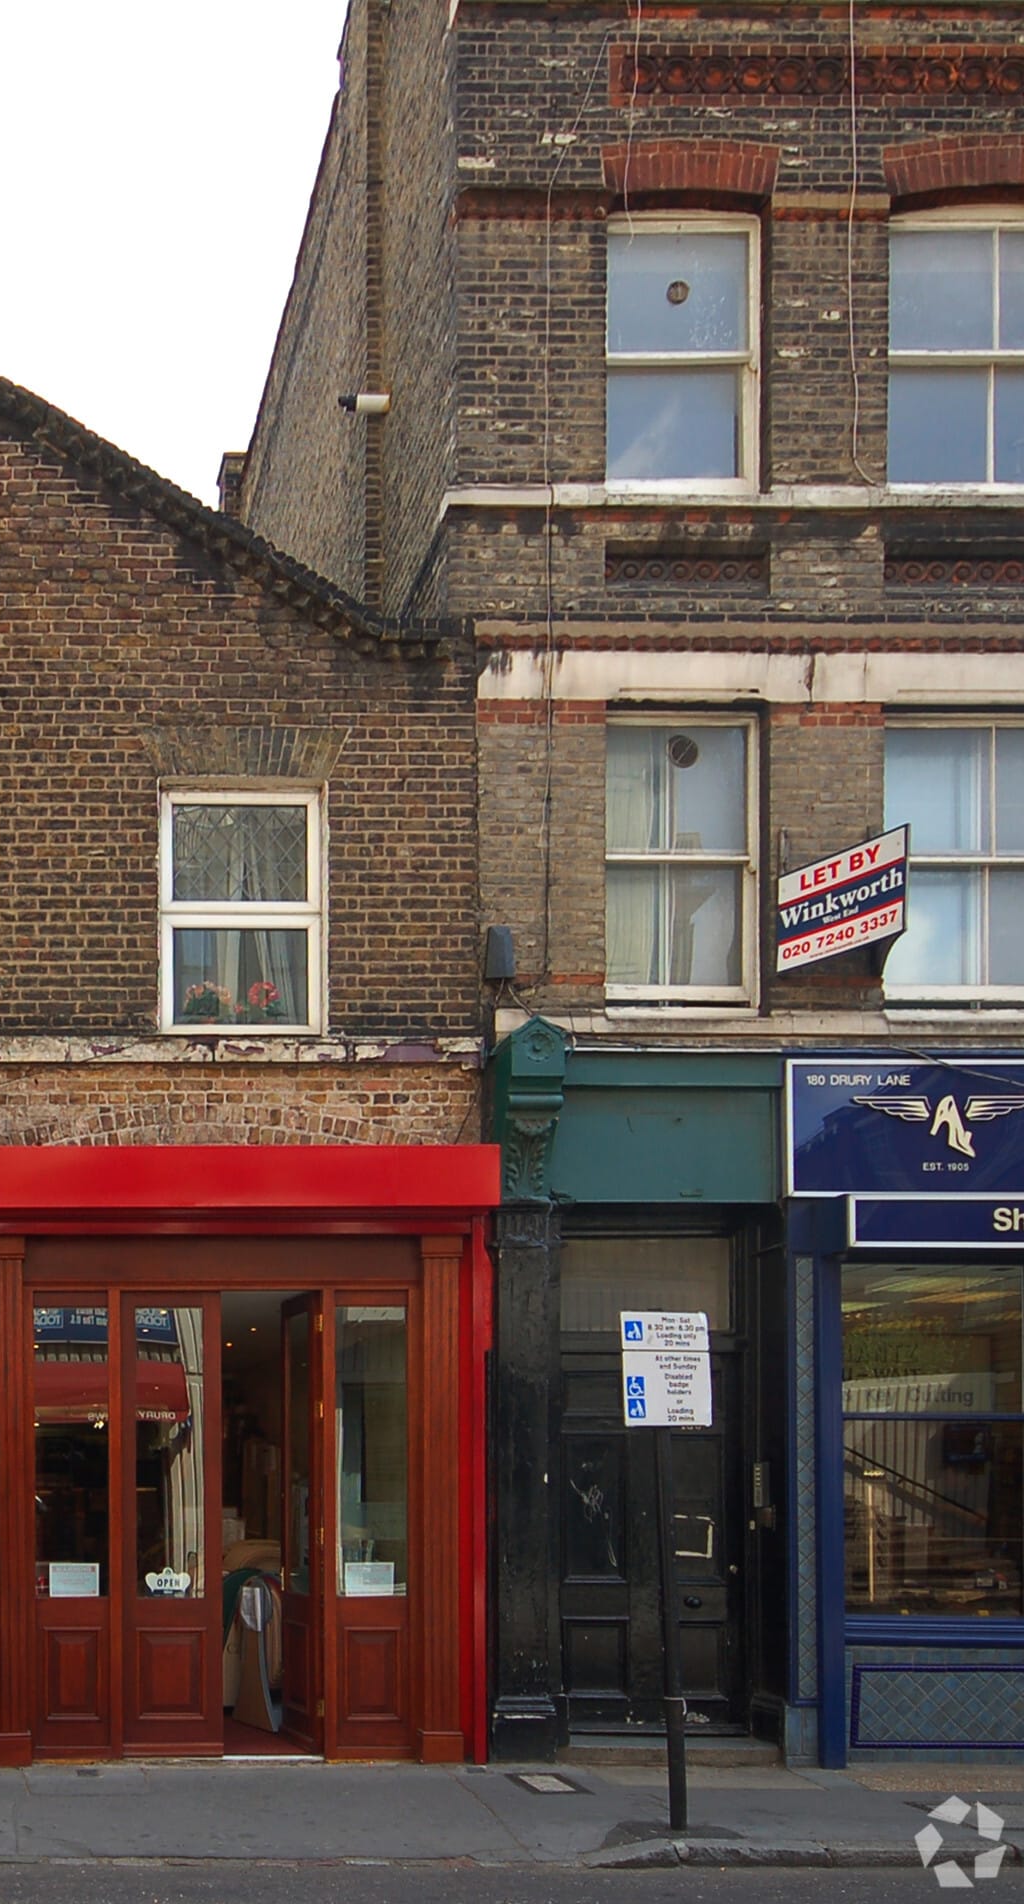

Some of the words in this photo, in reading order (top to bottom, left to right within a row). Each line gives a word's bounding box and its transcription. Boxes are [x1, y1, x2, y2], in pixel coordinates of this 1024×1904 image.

[799, 860, 842, 892] LET
[849, 844, 881, 872] BY
[780, 867, 904, 929] Winkworth
[782, 941, 811, 960] 020
[816, 926, 855, 949] 7240
[860, 909, 898, 933] 3337
[806, 1074, 826, 1086] 180
[830, 1074, 873, 1086] DRURY
[877, 1074, 912, 1086] LANE
[922, 1162, 944, 1172] EST.
[947, 1162, 969, 1172] 1905
[673, 1362, 697, 1370] Sunday
[664, 1372, 693, 1380] Disabled
[667, 1407, 694, 1415] Loading
[156, 1578, 180, 1588] OPEN
